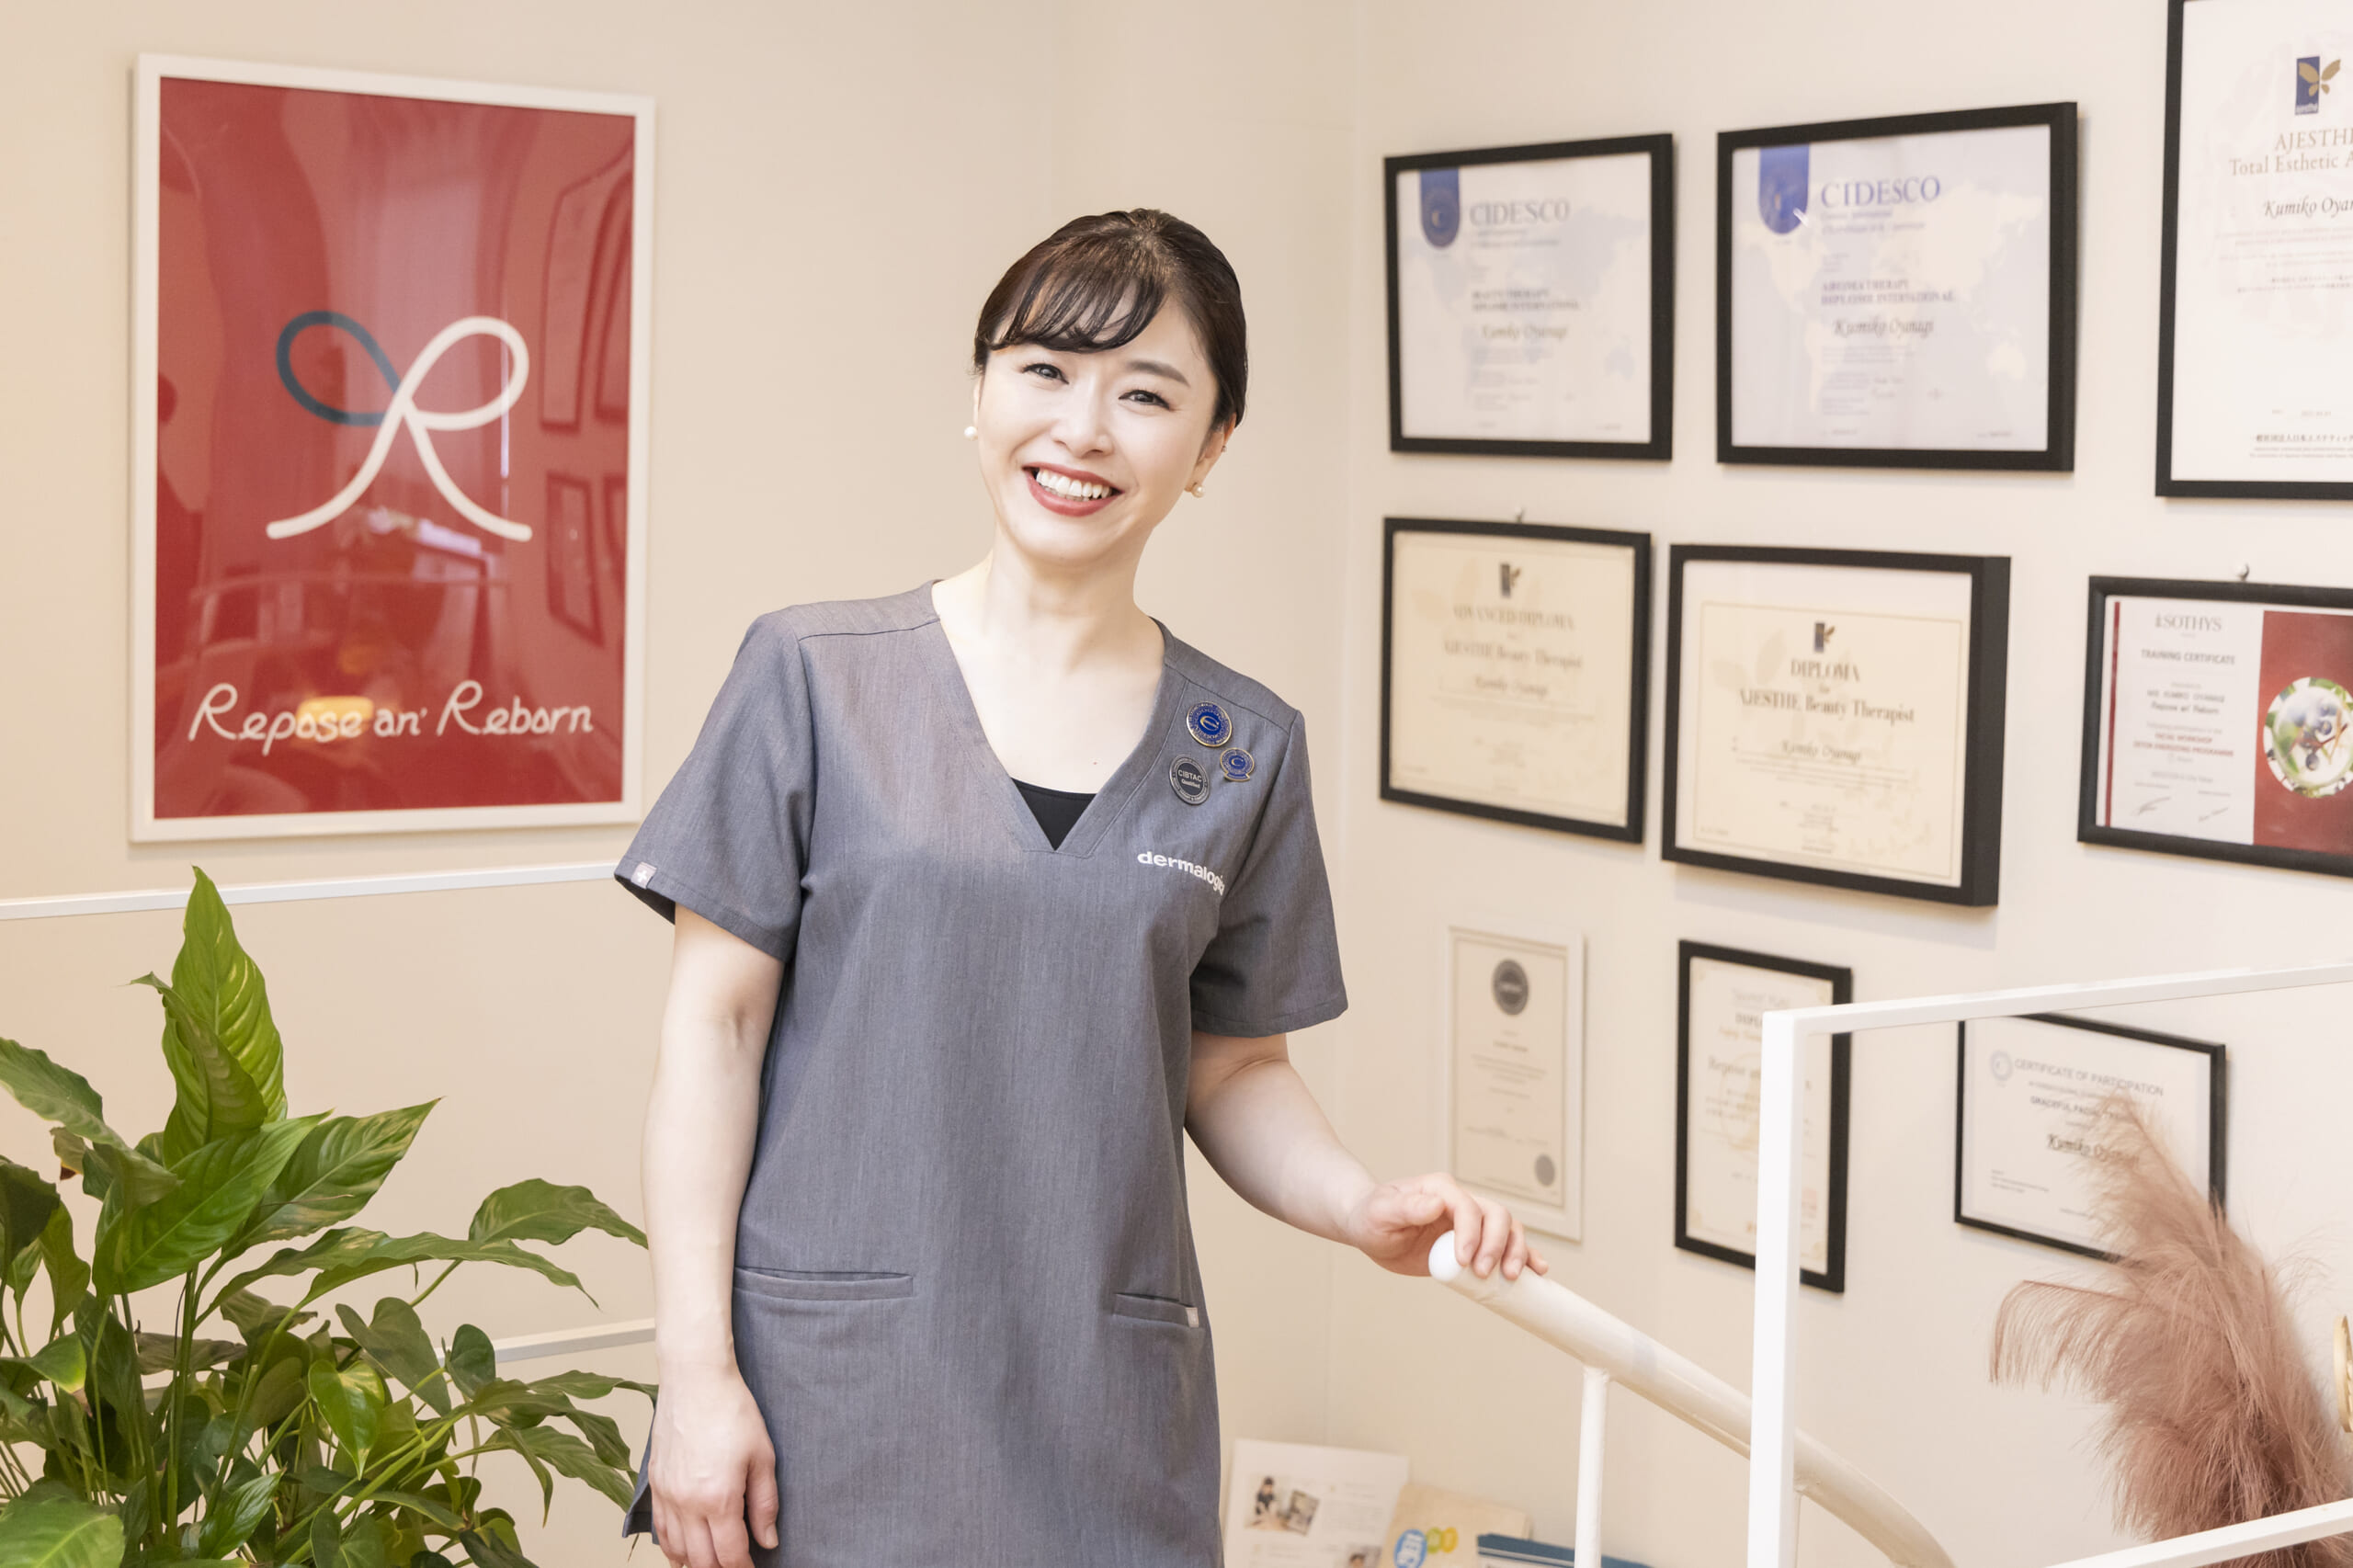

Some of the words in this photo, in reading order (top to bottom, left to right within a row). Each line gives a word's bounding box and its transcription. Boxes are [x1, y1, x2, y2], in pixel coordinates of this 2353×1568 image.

[2228, 154, 2268, 176] Total
[2275, 151, 2339, 174] Esthetic
[1821, 175, 1940, 208] CIDESCO
[1469, 198, 1571, 226] CIDESCO
[2264, 194, 2317, 219] Kumiko
[2163, 614, 2222, 632] SOTHYS
[2141, 648, 2181, 662] TRAINING
[2184, 652, 2235, 665] CERTIFICATE
[1790, 659, 1860, 683] DIPLOMA
[188, 683, 364, 756] Repose
[437, 679, 594, 736] Reborn
[1805, 696, 1847, 721] Beauty
[1852, 699, 1915, 727] Therapist
[1177, 769, 1202, 782] CIBTAC
[1137, 851, 1225, 896] dermalogi
[2015, 1058, 2074, 1080] CERTIFICATE
[2075, 1070, 2088, 1082] OF
[2091, 1073, 2164, 1096] PARTICIPATION
